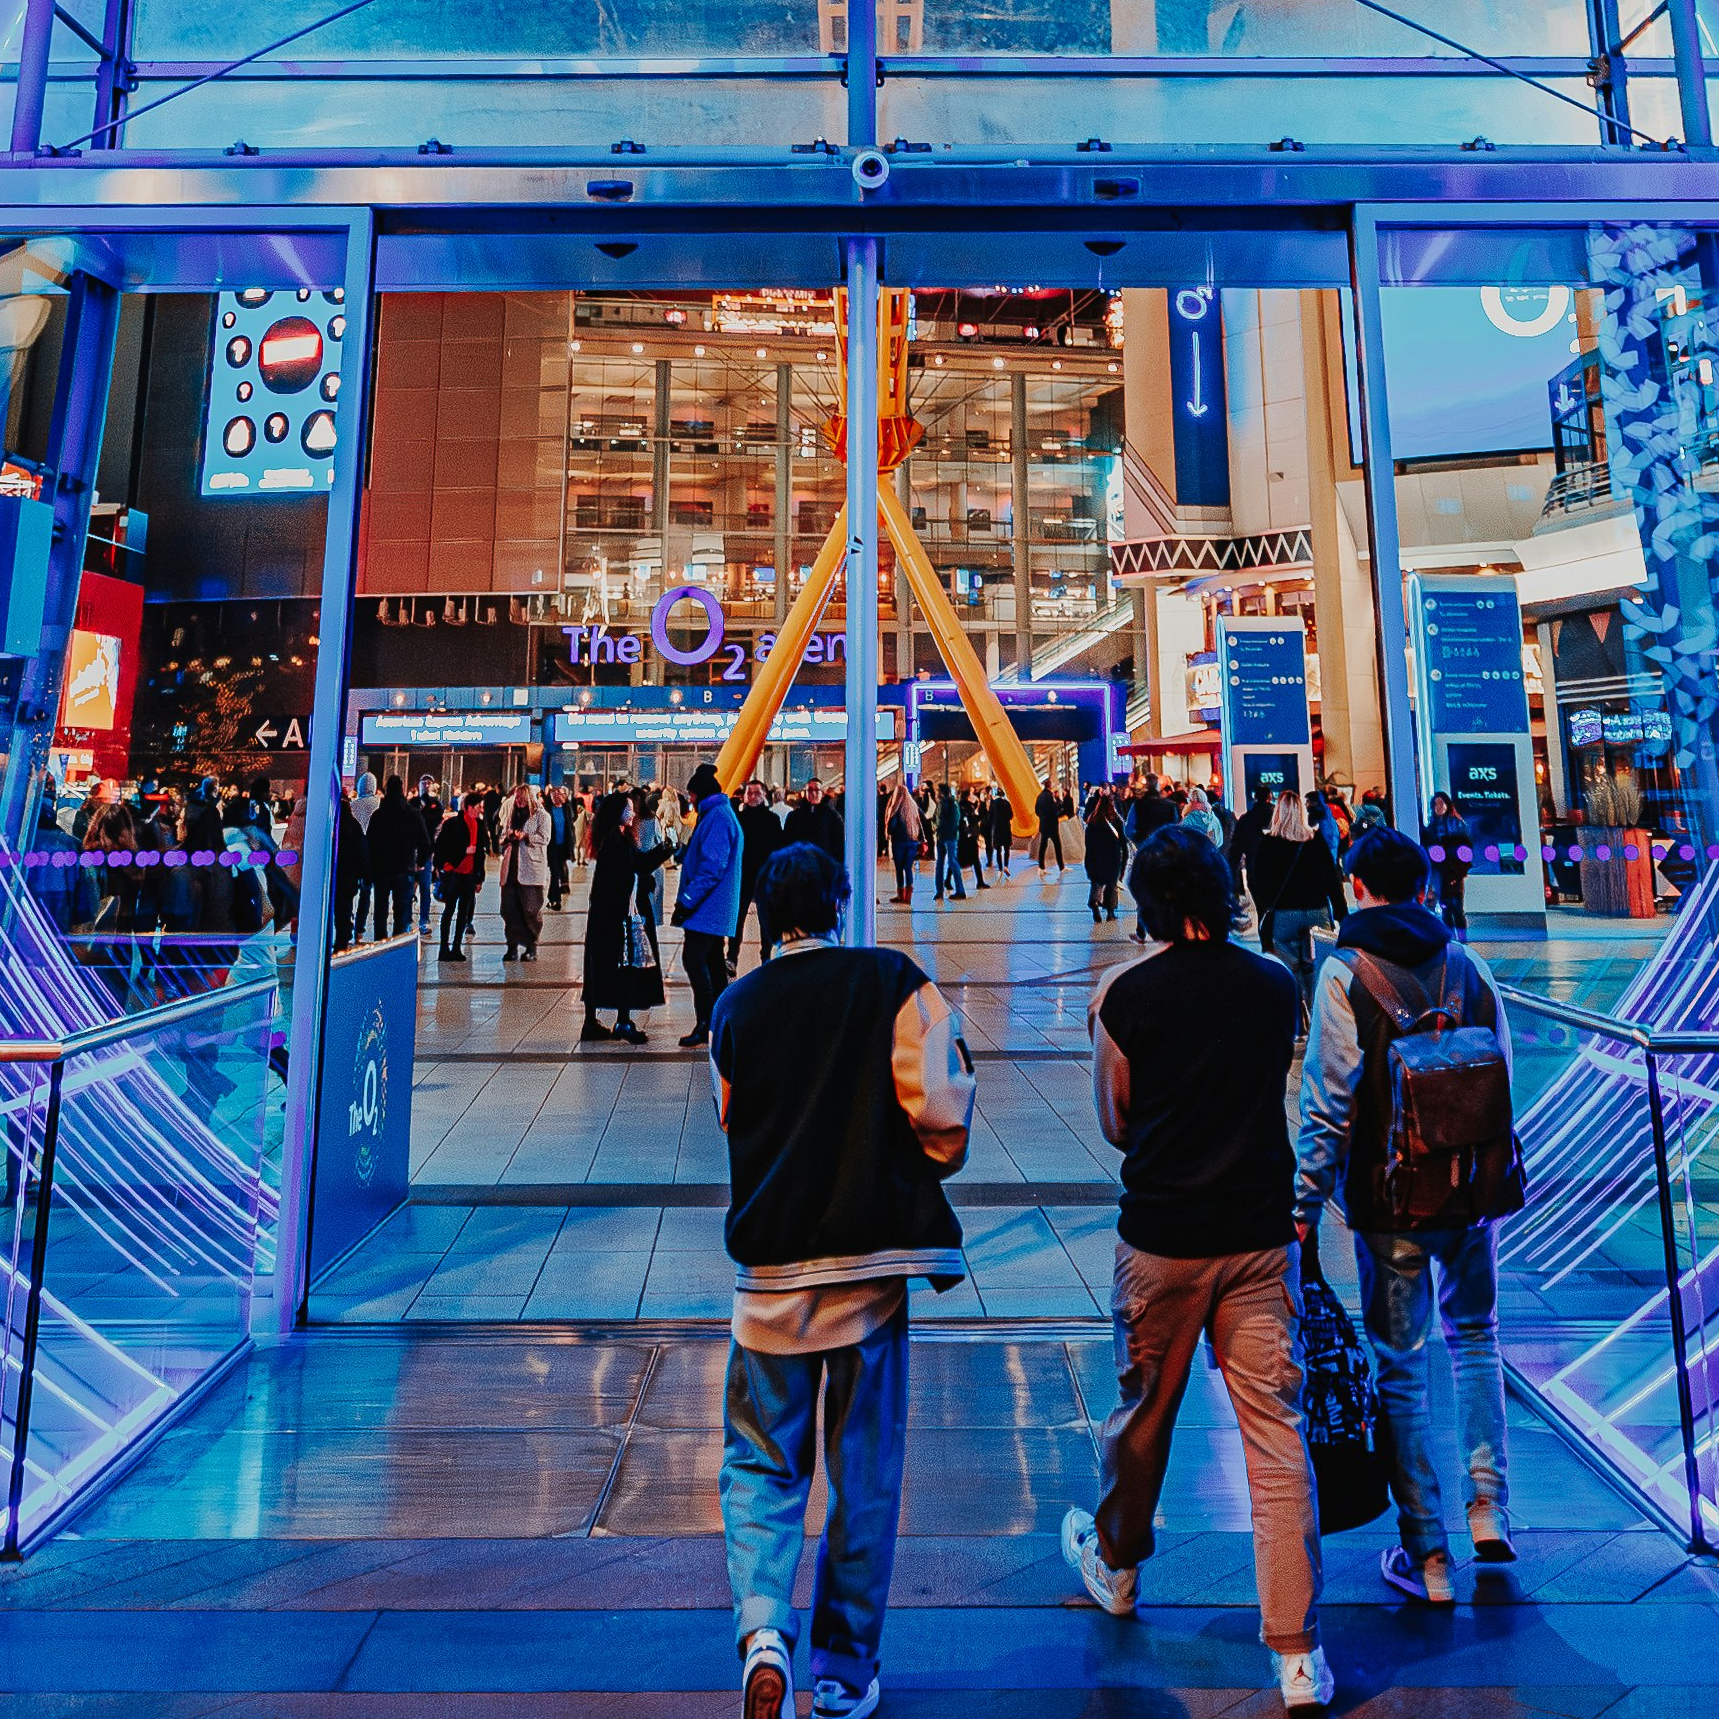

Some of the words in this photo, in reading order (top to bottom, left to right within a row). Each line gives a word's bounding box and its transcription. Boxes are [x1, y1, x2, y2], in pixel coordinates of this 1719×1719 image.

[562, 624, 641, 665] The
[650, 586, 746, 681] O2
[703, 690, 713, 703] B
[925, 689, 934, 701] B
[282, 718, 304, 749] A
[1260, 772, 1284, 784] axs
[1468, 767, 1497, 782] axs
